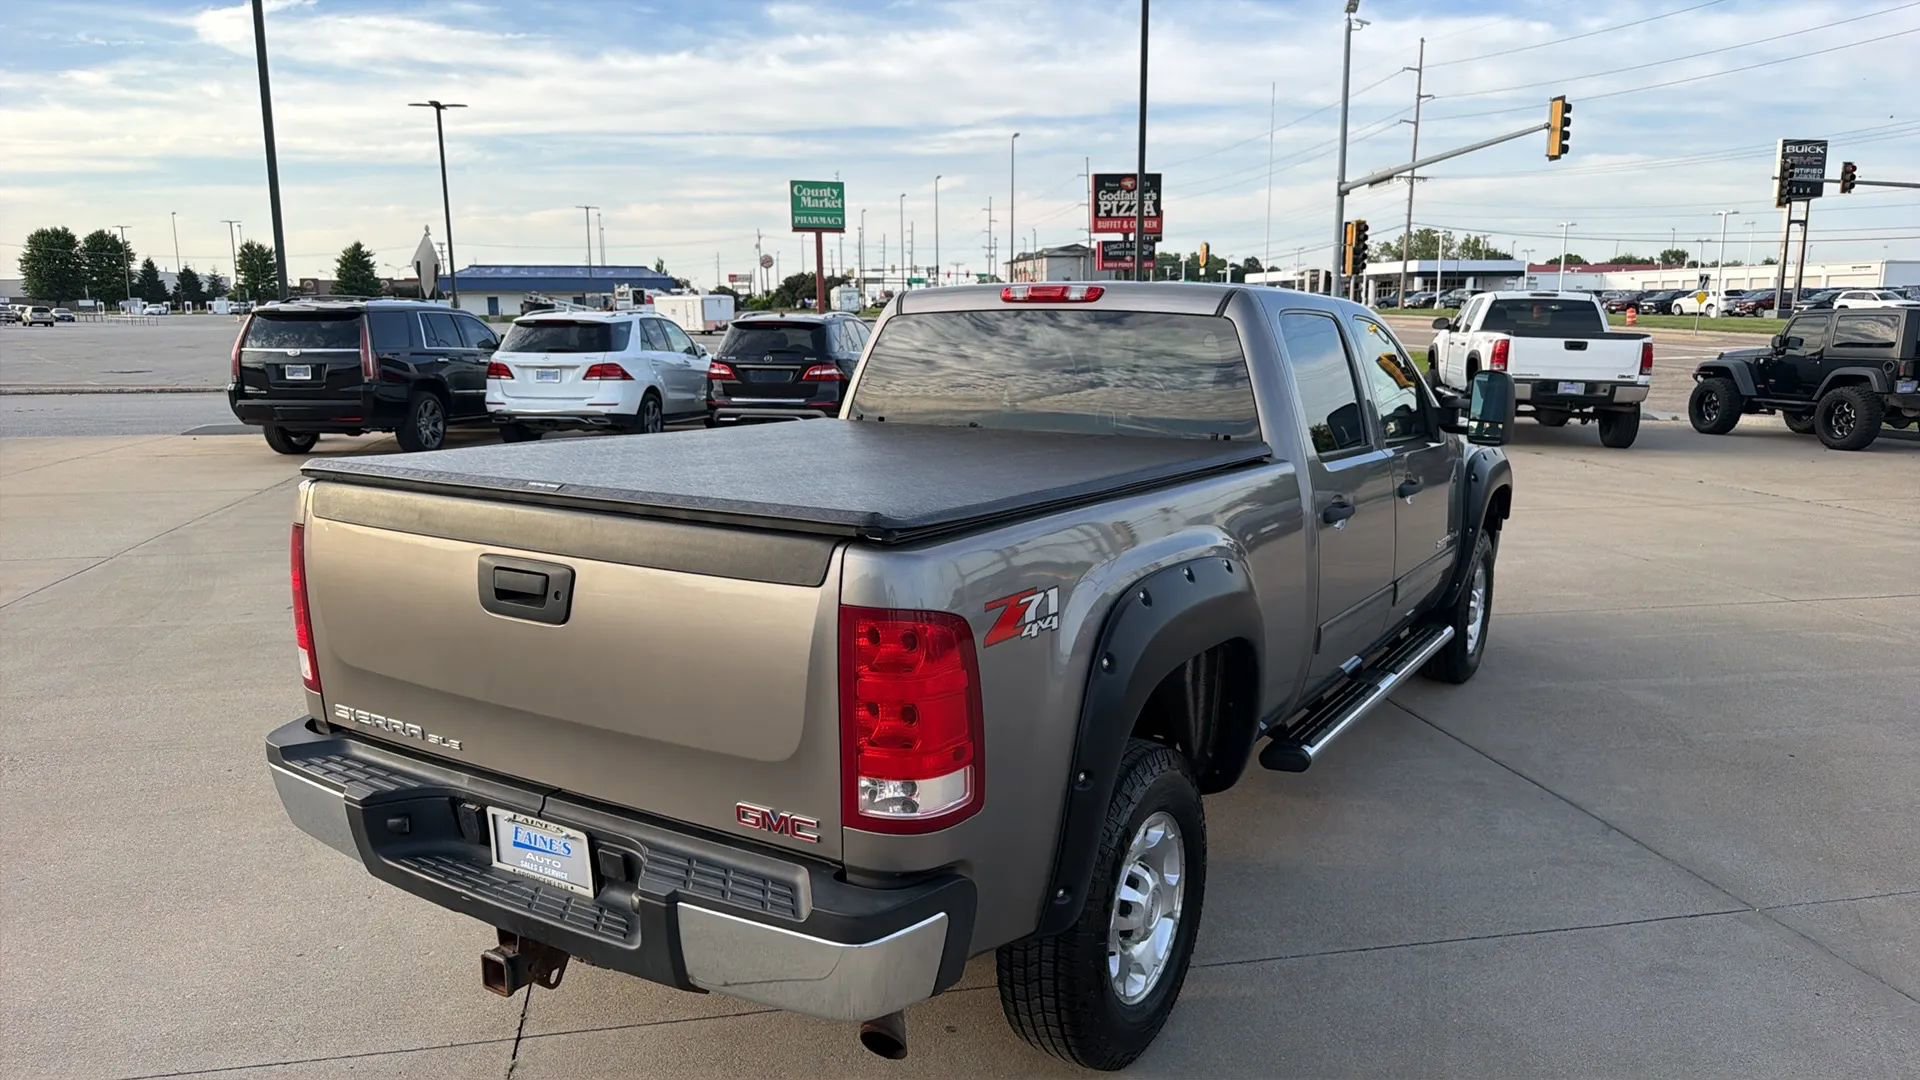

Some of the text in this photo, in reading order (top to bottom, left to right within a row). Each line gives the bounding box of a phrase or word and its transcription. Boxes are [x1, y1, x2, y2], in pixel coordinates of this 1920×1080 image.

[1786, 145, 1825, 154] BUICK
[793, 184, 839, 199] County
[800, 196, 842, 208] Market
[1098, 201, 1157, 217] PIZZA
[794, 216, 842, 225] PHARMACY
[1097, 220, 1121, 229] BUFFET
[1122, 220, 1128, 229] &
[983, 586, 1059, 648] Z71
[335, 703, 463, 751] SIERRA SLE
[512, 814, 565, 834] FAINE'S
[735, 801, 821, 844] GMC
[513, 826, 572, 856] FAINE'S
[526, 853, 562, 869] AUTO
[519, 860, 538, 872] SALES
[539, 865, 544, 873] &
[544, 867, 569, 881] SERVICE
